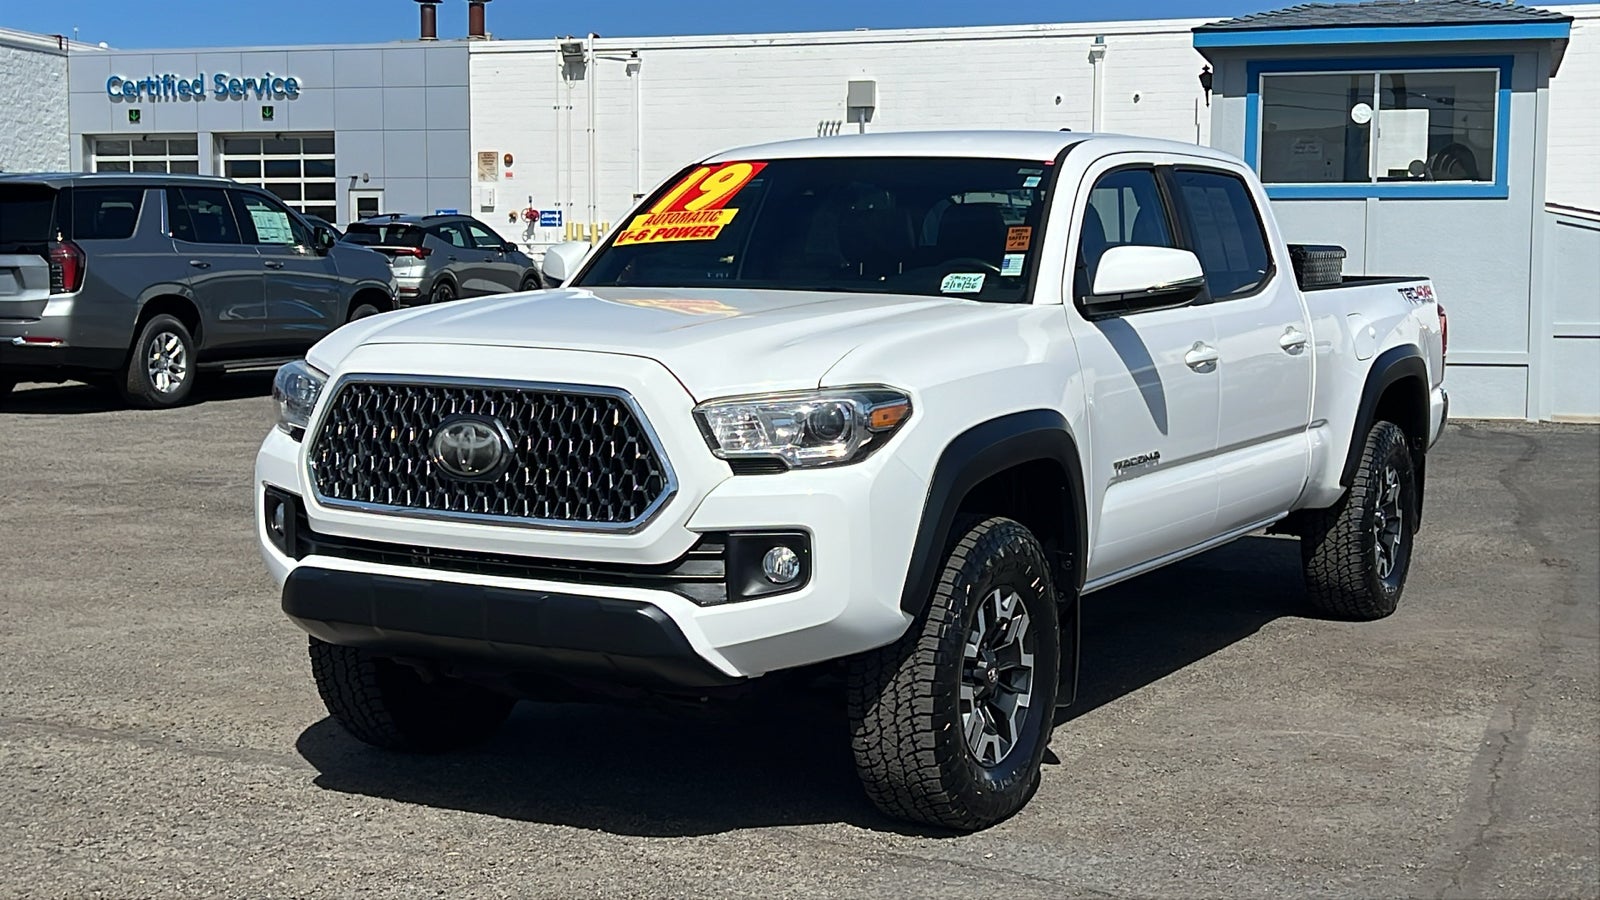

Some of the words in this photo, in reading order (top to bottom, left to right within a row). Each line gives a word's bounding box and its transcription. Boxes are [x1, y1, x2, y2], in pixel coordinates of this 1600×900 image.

[107, 73, 204, 97] Certified
[214, 73, 300, 95] Service
[650, 163, 753, 213] 19
[642, 211, 723, 226] AUTOMATIC
[616, 230, 651, 244] V-6
[650, 225, 720, 240] POWER
[1113, 450, 1161, 470] TACOMA
